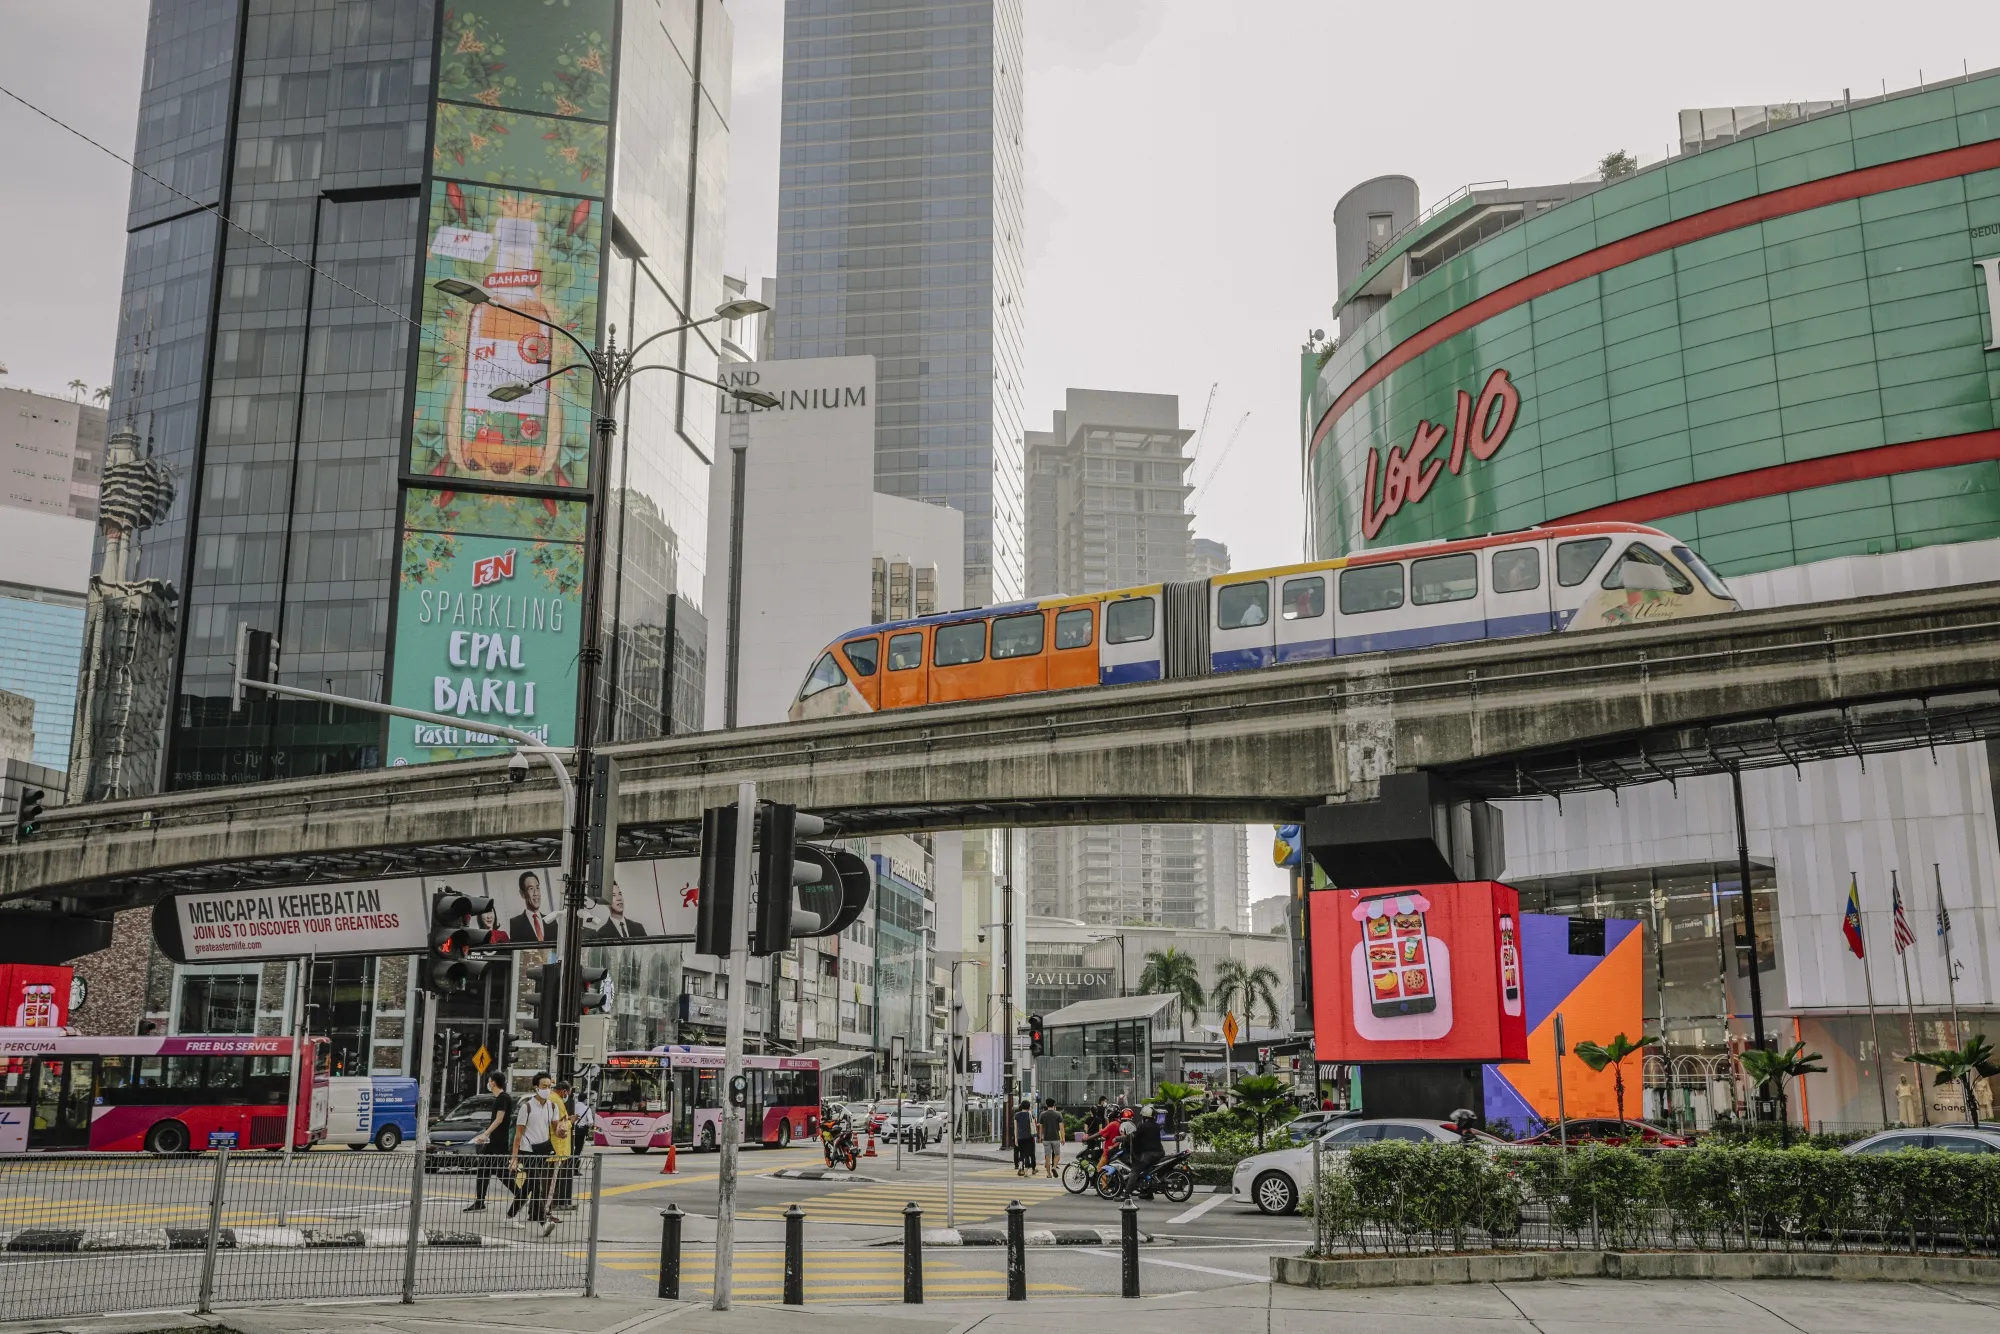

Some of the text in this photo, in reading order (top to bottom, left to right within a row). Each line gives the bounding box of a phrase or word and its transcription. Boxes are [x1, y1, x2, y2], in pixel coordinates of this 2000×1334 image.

[488, 272, 538, 287] BAHARU
[717, 371, 760, 387] AND
[1362, 368, 1520, 540] Lot 10
[472, 547, 516, 589] F&N
[419, 590, 563, 631] SPARKLING
[449, 631, 526, 671] EPAL
[434, 676, 537, 718] BARLI
[188, 888, 381, 924] MENCAPAI KEHEBATAN
[193, 913, 399, 940] JOIN US TO DISCOVER YOUR GREATNESS
[194, 940, 262, 955] greateasternlife.com
[1026, 972, 1108, 986] PAVILION
[4, 1042, 57, 1052] PERCUMA
[186, 1042, 278, 1052] FREE BUS SERVICE
[356, 1088, 370, 1131] Initial
[1933, 1104, 1966, 1114] Chang
